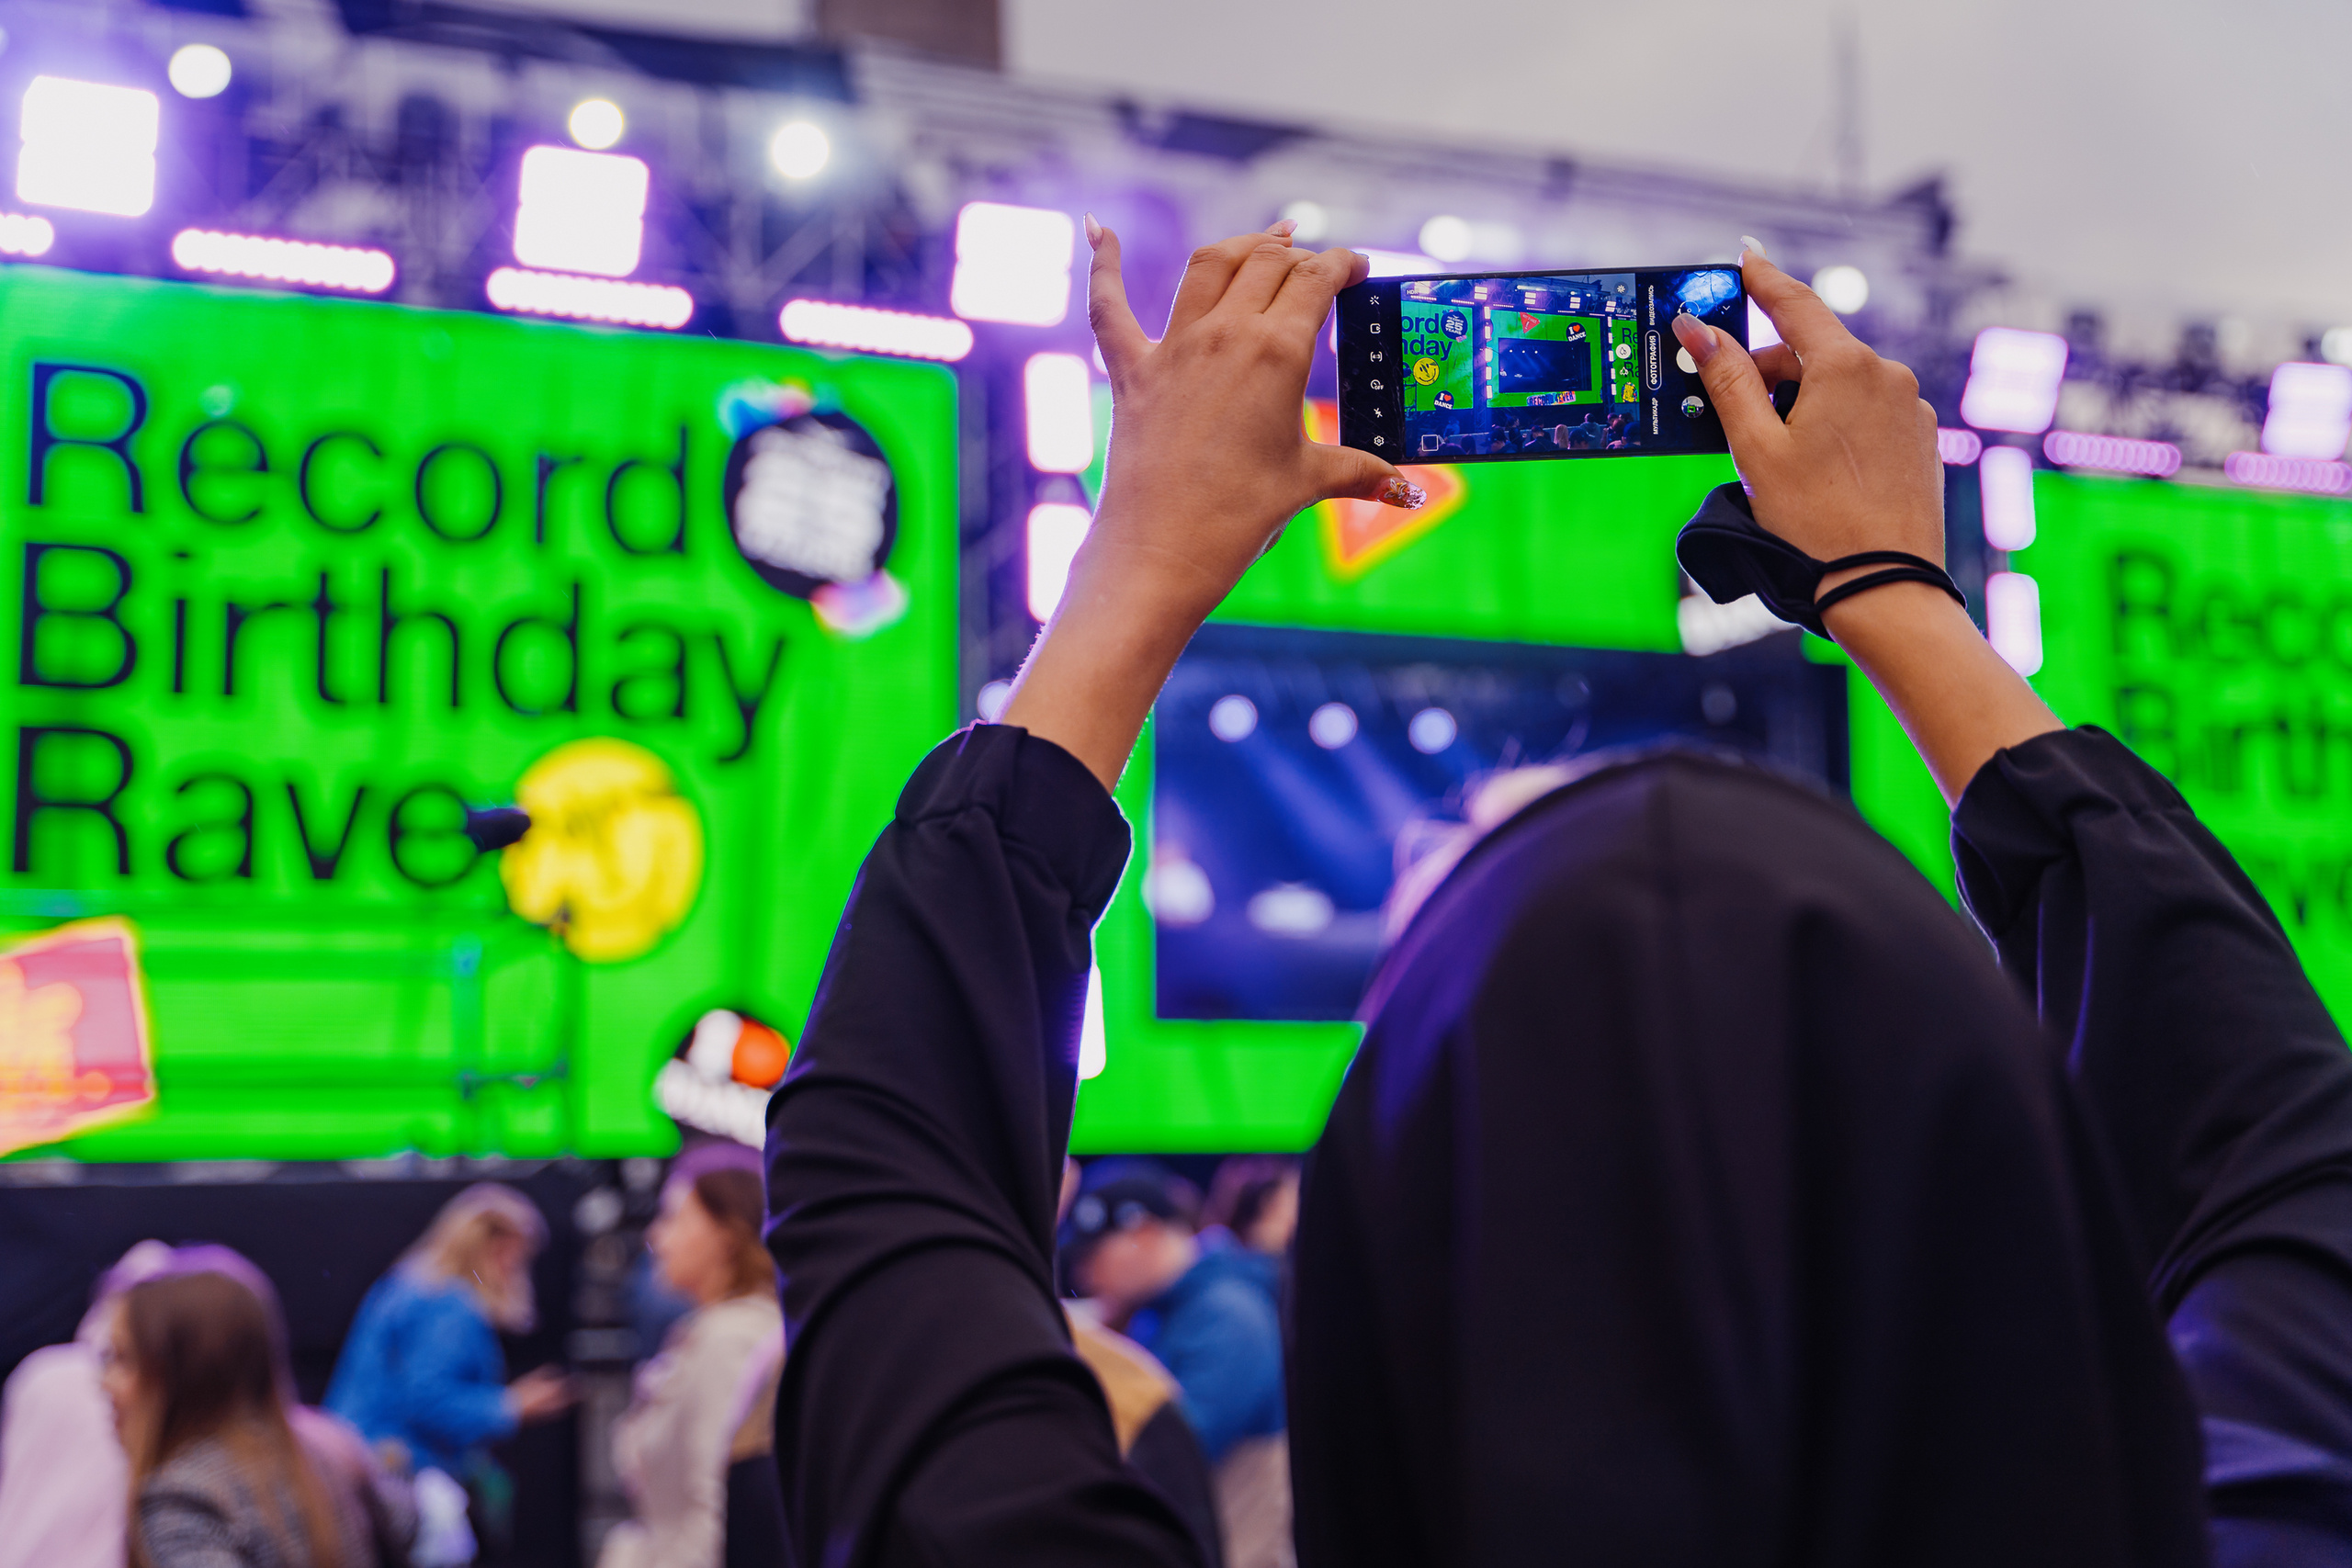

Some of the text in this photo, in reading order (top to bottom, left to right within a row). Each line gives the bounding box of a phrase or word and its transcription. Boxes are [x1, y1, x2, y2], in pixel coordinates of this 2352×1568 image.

[1445, 319, 1464, 332] 25
[1567, 332, 1587, 342] DANCE
[1649, 335, 1657, 385] ФОТОГРАФИЯ
[1433, 400, 1453, 410] DANCE
[28, 361, 689, 556] Record
[17, 540, 786, 766] Birthday
[12, 726, 487, 890] Rave
